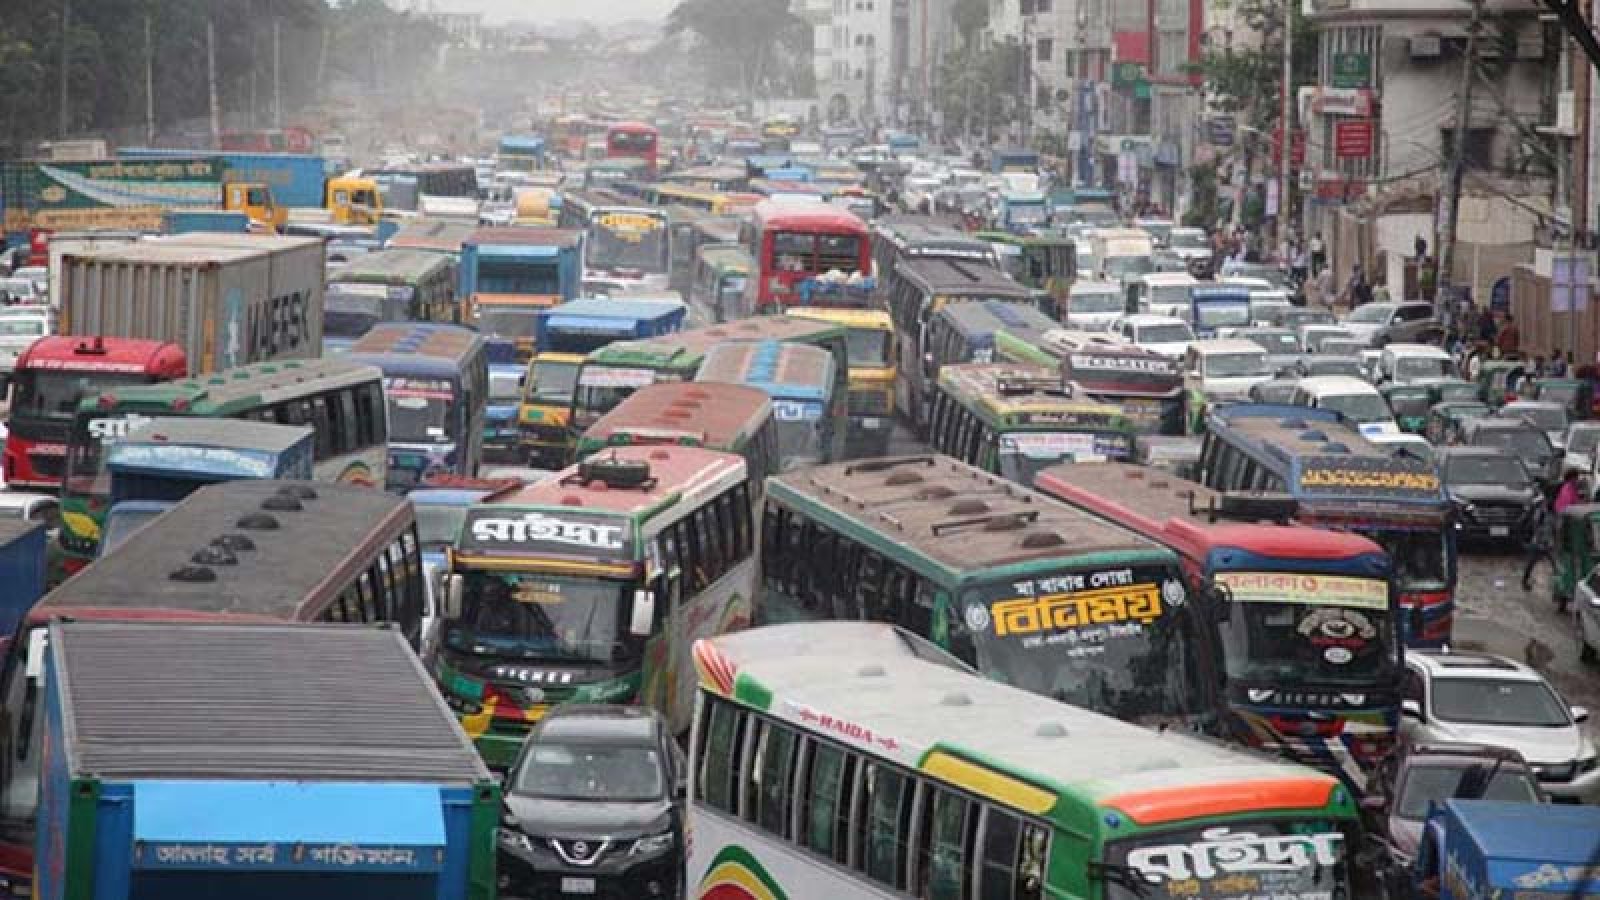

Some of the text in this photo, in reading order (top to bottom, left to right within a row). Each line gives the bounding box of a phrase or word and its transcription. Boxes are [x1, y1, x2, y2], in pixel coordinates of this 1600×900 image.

[472, 513, 622, 549] রাইদা
[990, 582, 1163, 637] বিনিময়
[819, 714, 873, 743] RAIDA
[1126, 826, 1345, 883] রাইদা
